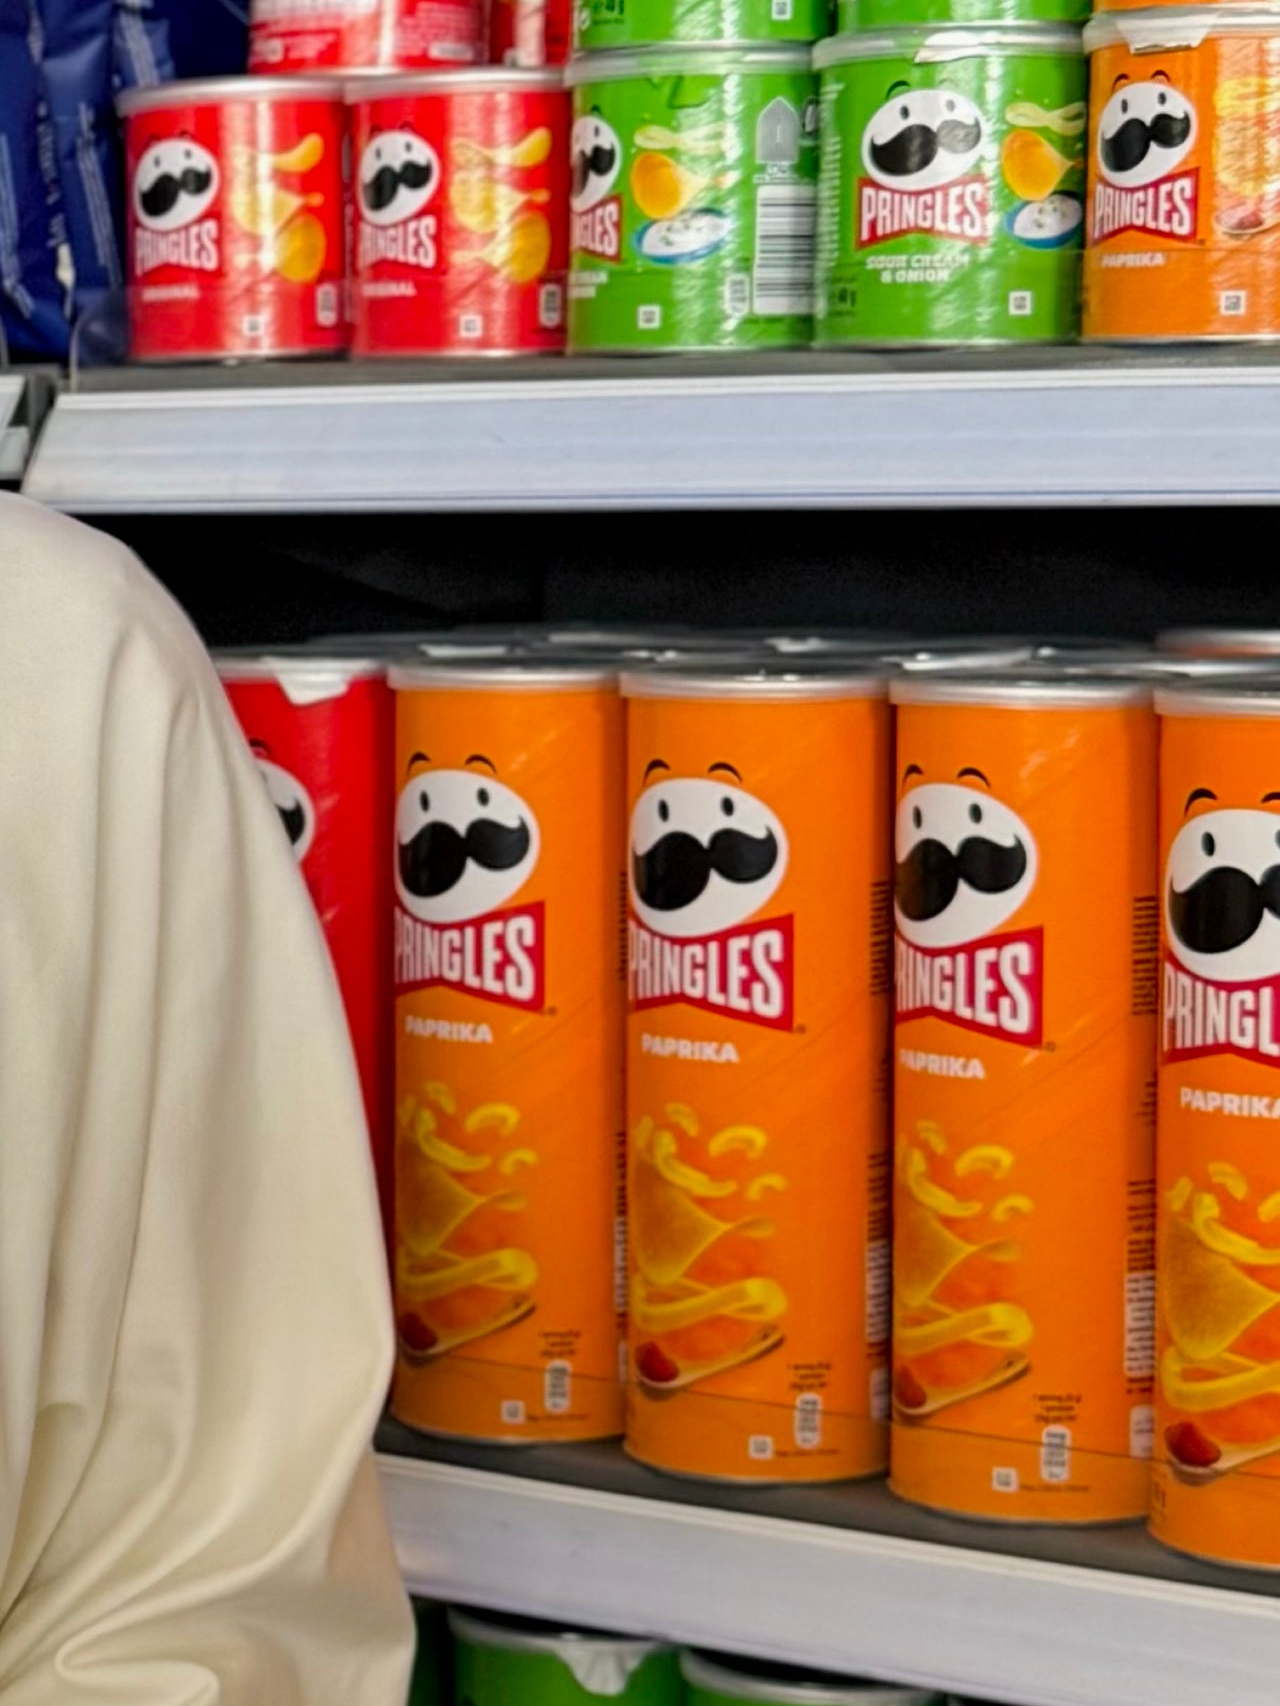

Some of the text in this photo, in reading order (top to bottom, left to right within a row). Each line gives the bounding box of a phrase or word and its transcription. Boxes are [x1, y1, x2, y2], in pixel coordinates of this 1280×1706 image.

[860, 181, 985, 240] PRINGLES
[1094, 174, 1193, 243] PRINGLES
[405, 1015, 493, 1044] PAPRIKA
[1163, 960, 1280, 1058] PRINGL
[642, 1031, 741, 1064] PAPRIKA
